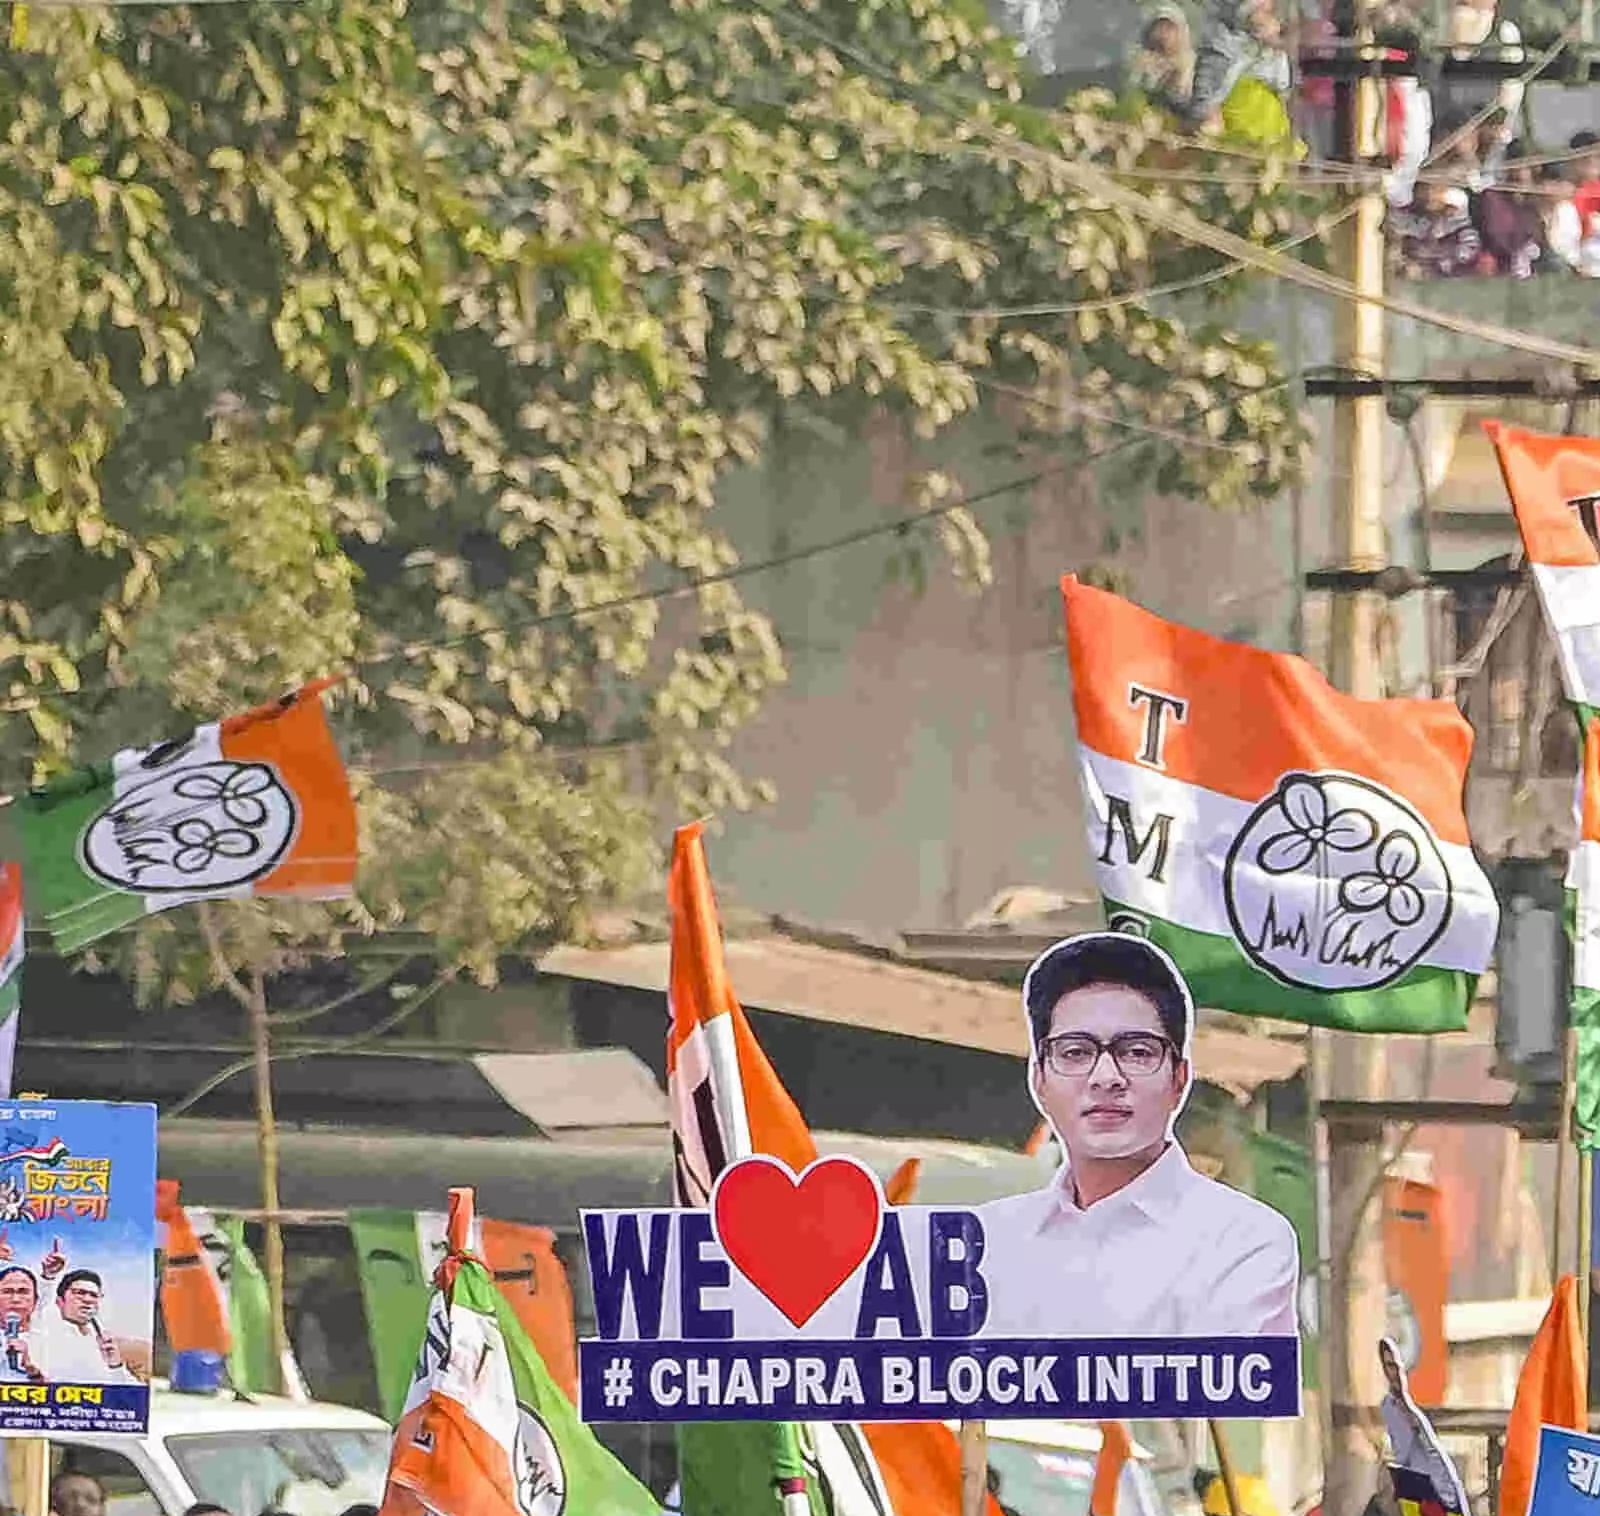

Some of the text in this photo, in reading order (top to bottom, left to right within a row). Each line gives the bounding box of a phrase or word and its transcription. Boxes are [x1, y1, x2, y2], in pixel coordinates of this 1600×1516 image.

[1130, 686, 1184, 767] T
[1097, 793, 1175, 882] M
[585, 1211, 989, 1341] WE AB
[649, 1356, 866, 1406] CHAPRA
[881, 1355, 1058, 1405] BLOCK
[1077, 1353, 1274, 1403] INTTUC
